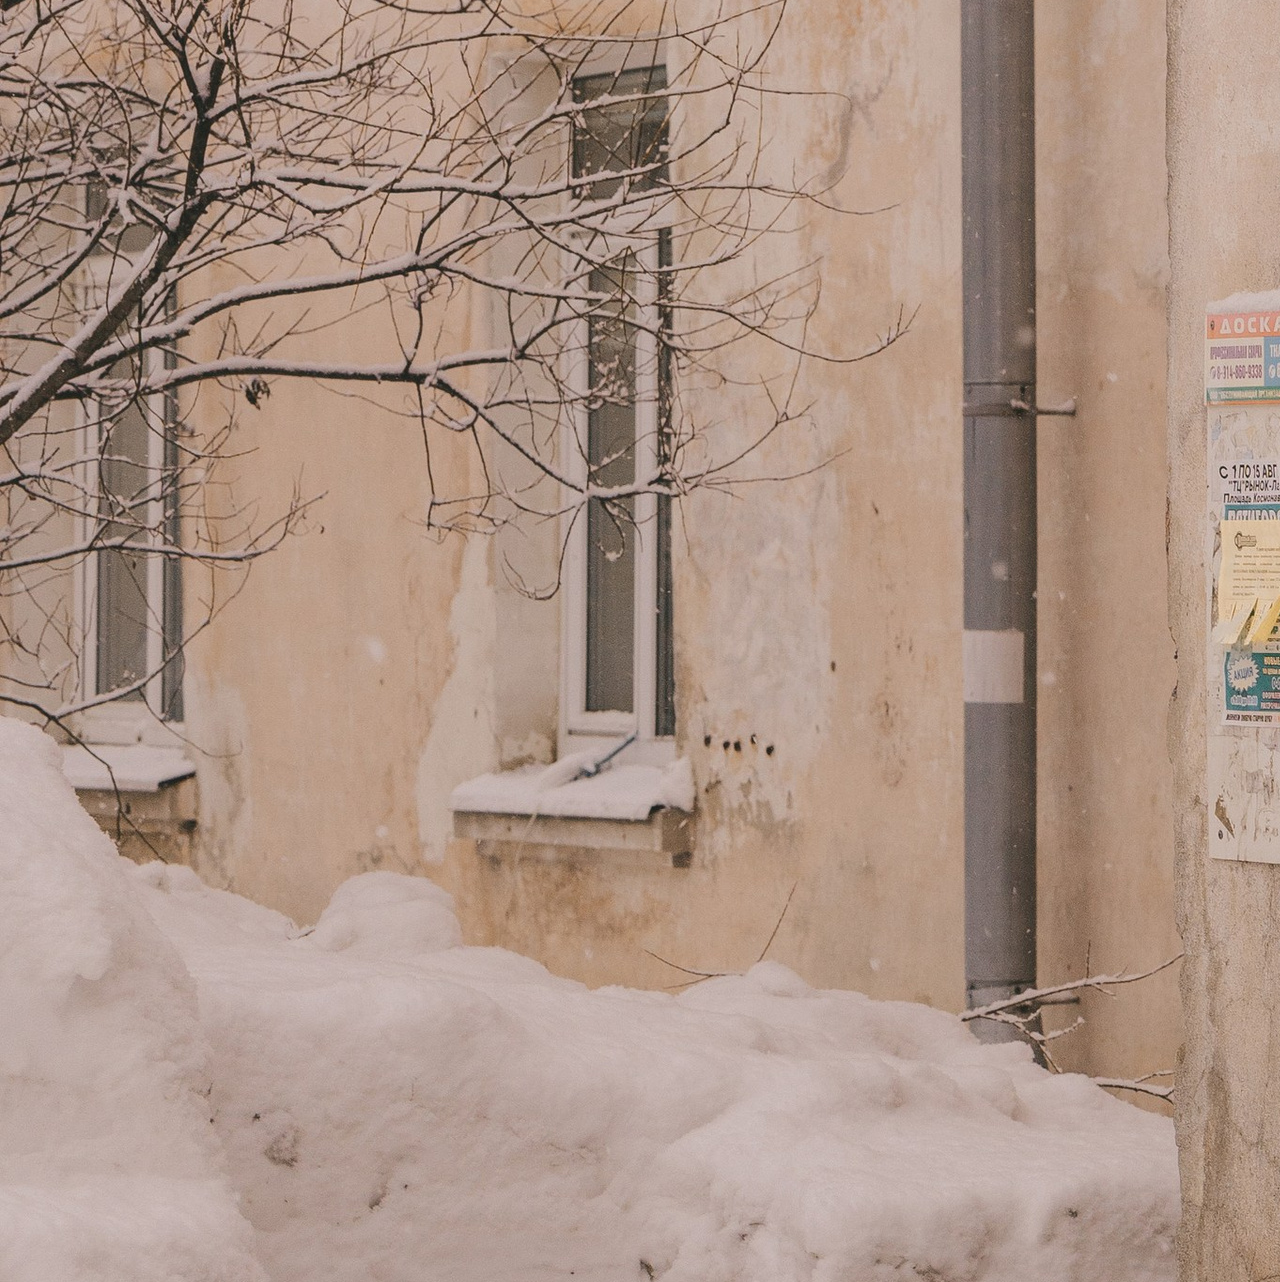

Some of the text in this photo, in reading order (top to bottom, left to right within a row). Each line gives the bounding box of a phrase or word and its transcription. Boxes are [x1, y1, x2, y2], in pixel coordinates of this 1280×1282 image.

[1219, 466, 1228, 479] С
[1232, 465, 1237, 478] 1
[1239, 464, 1251, 478] ПО
[1253, 464, 1260, 478] 15
[1223, 493, 1252, 504] Площадь
[1233, 666, 1254, 681] АКЦИЯ
